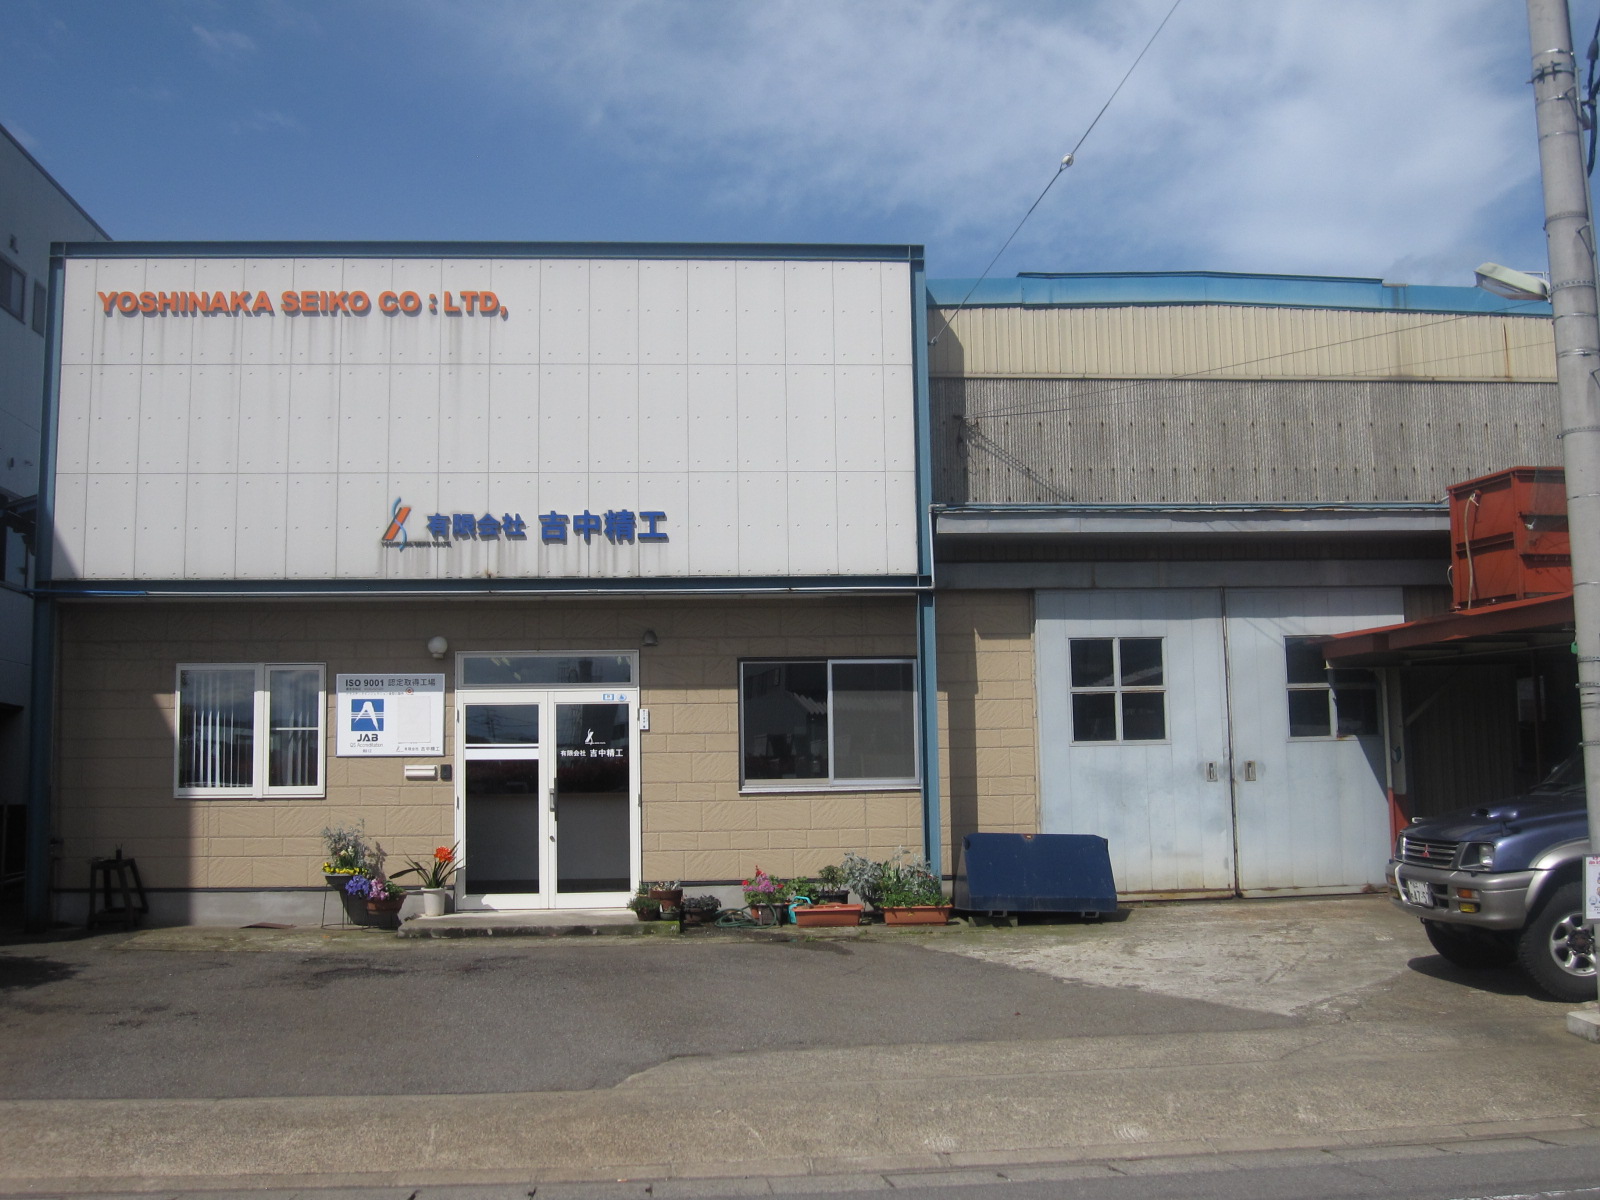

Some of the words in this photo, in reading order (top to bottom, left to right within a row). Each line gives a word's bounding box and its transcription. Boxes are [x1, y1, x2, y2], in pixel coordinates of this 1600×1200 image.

[98, 291, 274, 317] YOSHINAKA
[281, 290, 371, 316] SEIKO
[427, 512, 527, 541] 有限会社
[538, 509, 669, 545] 吉中精工
[345, 679, 361, 687] ISO
[364, 679, 384, 687] 9001
[357, 734, 379, 742] JAB
[589, 748, 623, 758] 吉中精工
